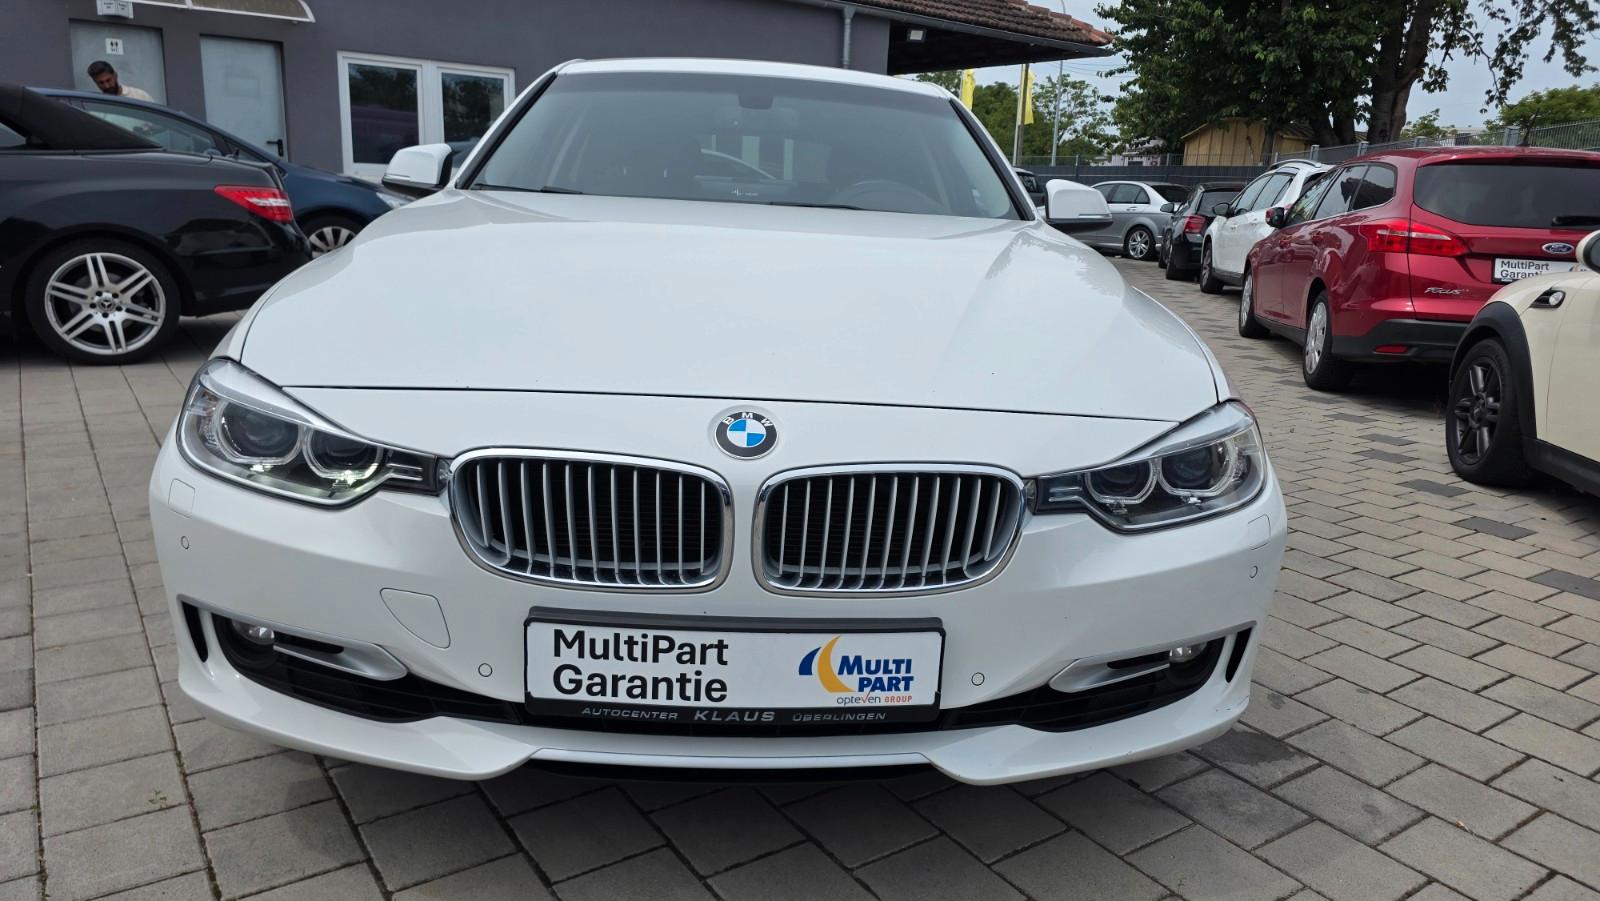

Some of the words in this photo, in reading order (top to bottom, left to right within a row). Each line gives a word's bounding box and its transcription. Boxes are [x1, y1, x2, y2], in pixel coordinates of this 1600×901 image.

[1500, 260, 1550, 270] MultiPart
[1500, 269, 1542, 279] Garant
[722, 412, 773, 427] BMW
[553, 629, 729, 666] MultiPart
[837, 655, 912, 675] MULTI
[553, 663, 728, 703] Garantie
[858, 676, 914, 692] PART
[836, 690, 881, 707] opteven
[884, 695, 913, 703] GROUP
[581, 707, 679, 720] AUTOCENTER
[694, 710, 776, 722] KLAUS
